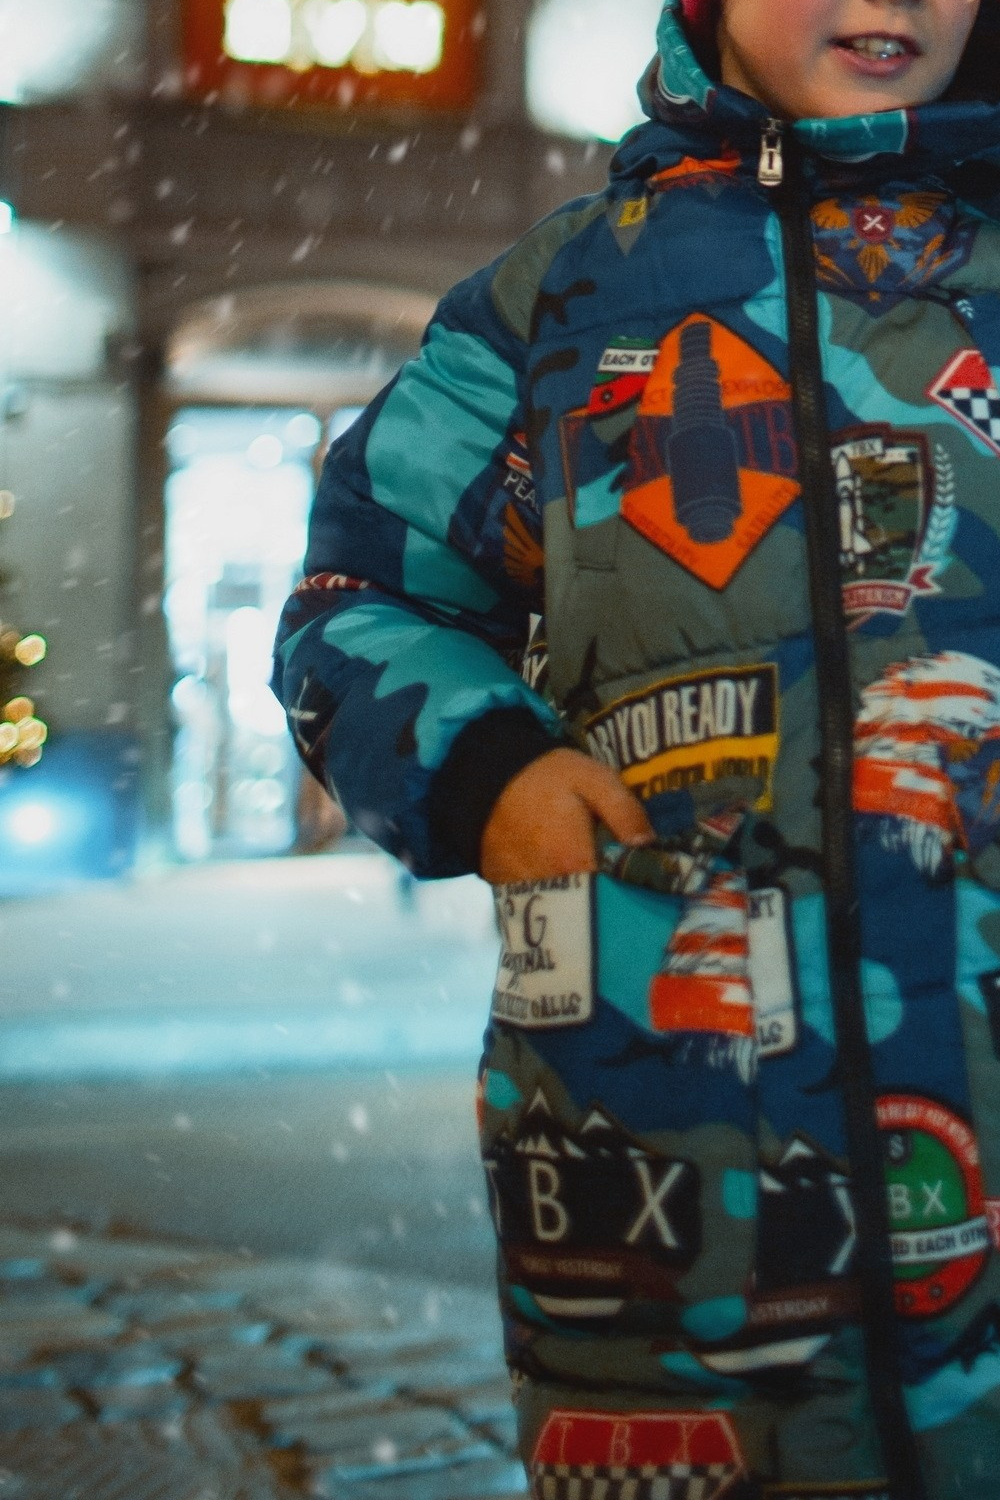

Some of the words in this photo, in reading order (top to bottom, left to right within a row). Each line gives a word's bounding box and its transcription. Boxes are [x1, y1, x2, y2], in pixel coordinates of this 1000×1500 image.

[602, 353, 636, 366] EACH
[662, 678, 758, 746] READY
[916, 1233, 957, 1255] EACH
